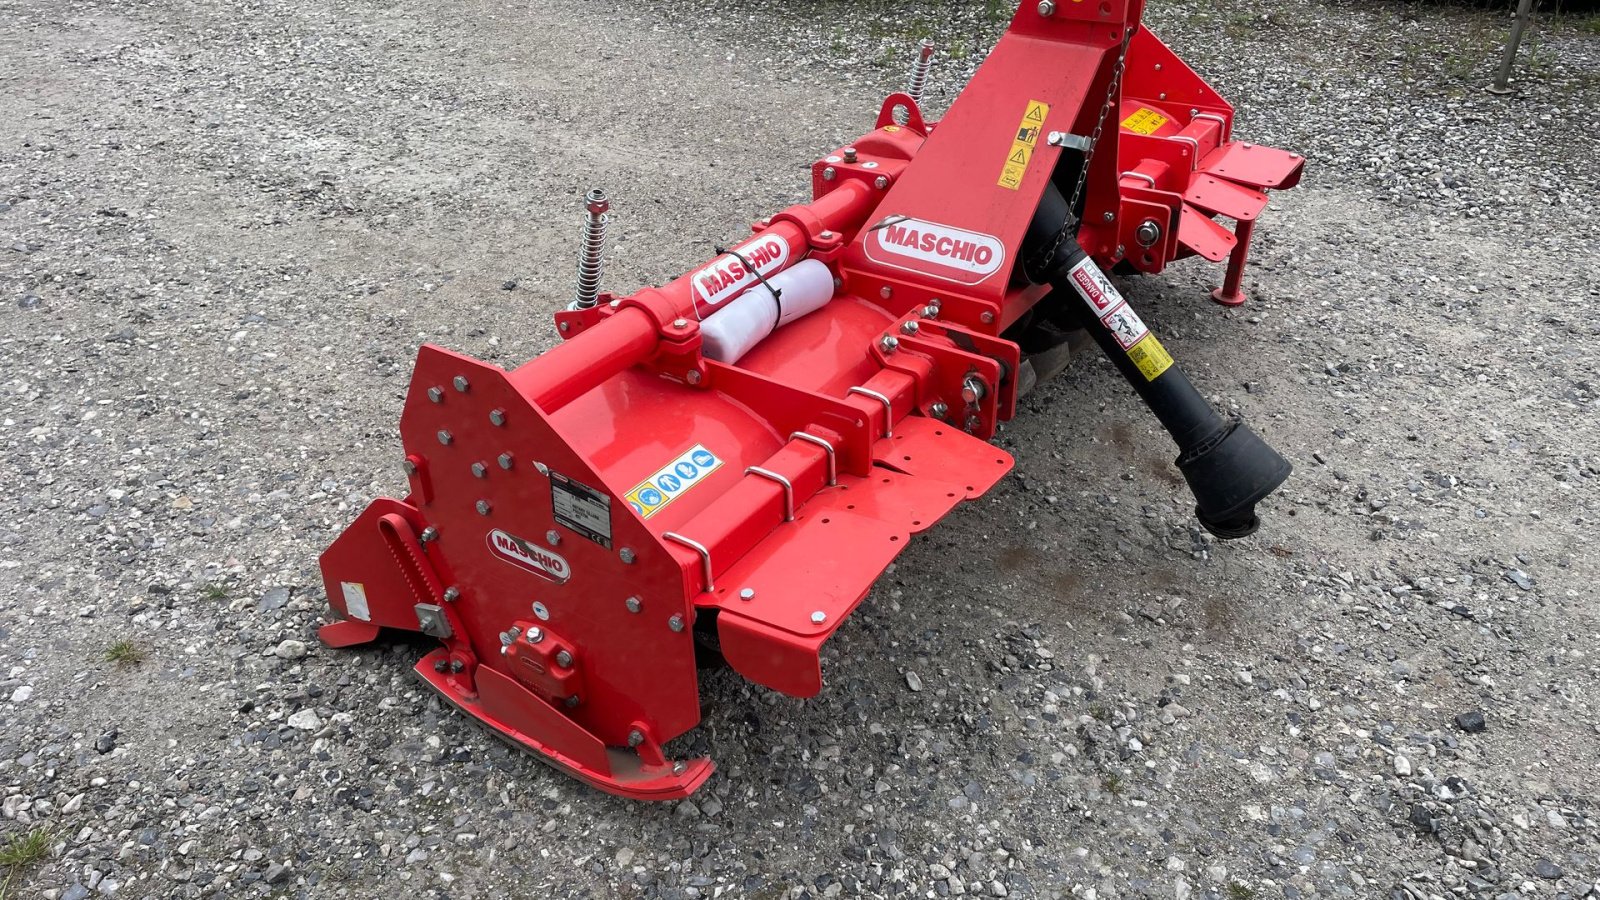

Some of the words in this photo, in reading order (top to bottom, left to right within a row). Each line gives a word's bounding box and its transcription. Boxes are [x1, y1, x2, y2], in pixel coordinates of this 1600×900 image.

[885, 225, 993, 265] MASCHIO
[700, 241, 781, 297] MASCHIO
[1076, 271, 1099, 297] DANGER
[496, 535, 563, 572] MASCHIO
